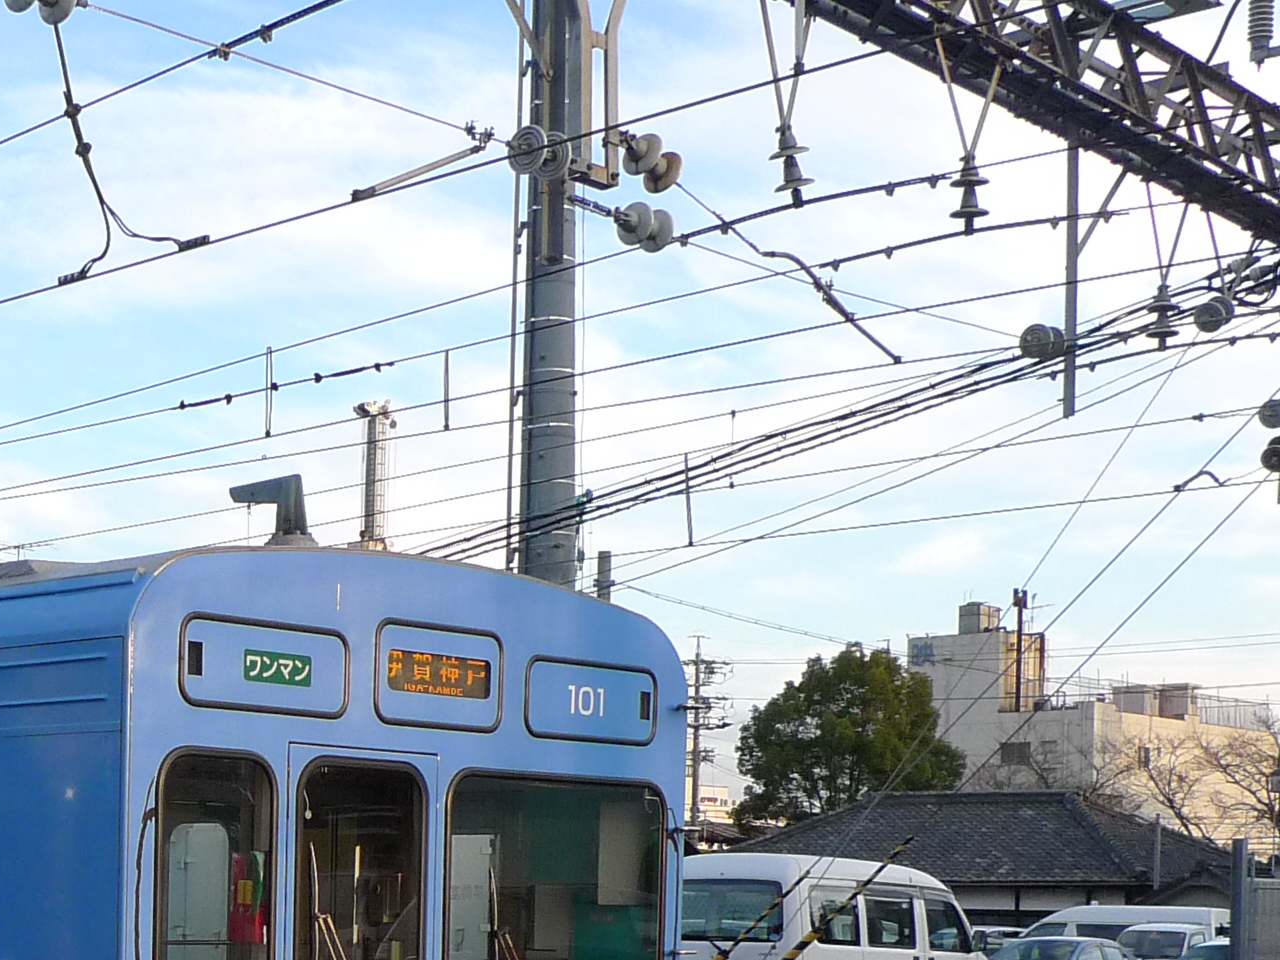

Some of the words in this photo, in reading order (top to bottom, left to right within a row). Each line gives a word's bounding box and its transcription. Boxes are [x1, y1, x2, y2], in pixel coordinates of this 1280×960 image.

[246, 655, 310, 681] ワンマン
[568, 685, 604, 717] 101
